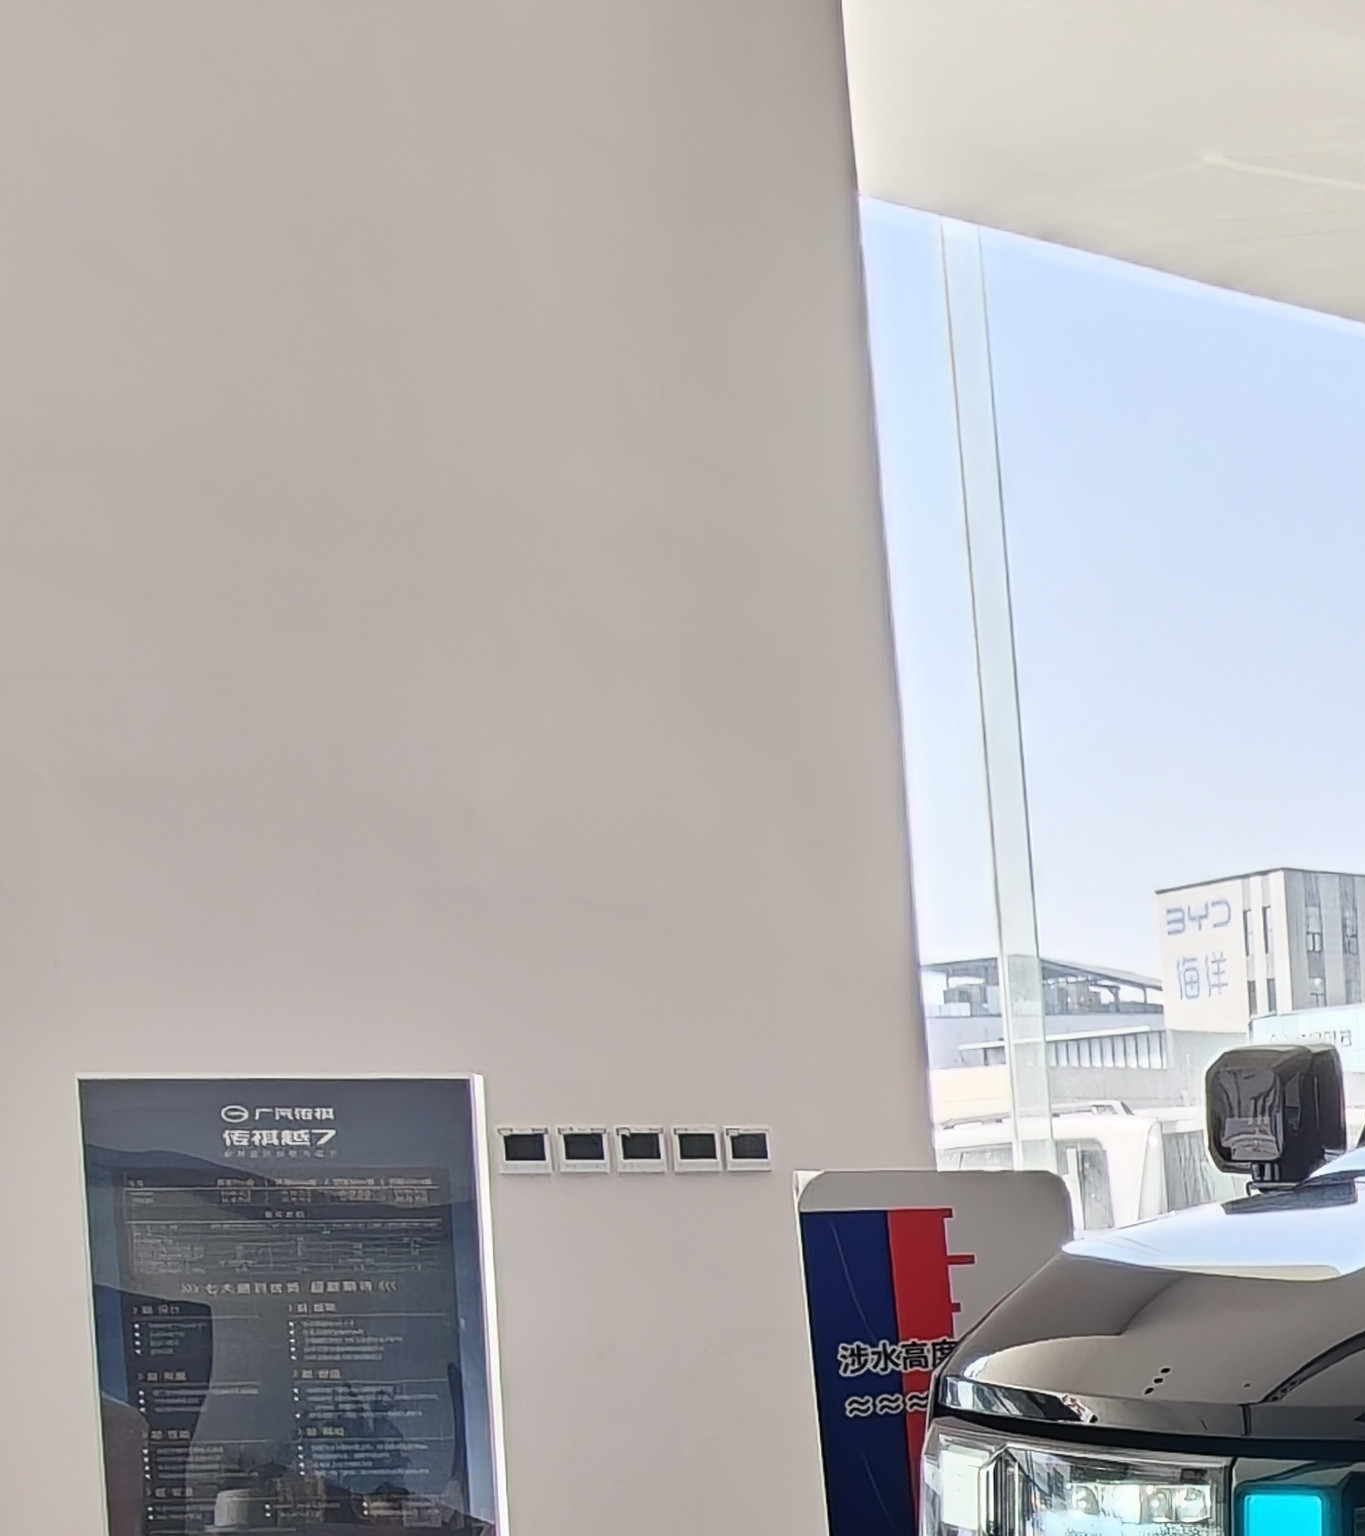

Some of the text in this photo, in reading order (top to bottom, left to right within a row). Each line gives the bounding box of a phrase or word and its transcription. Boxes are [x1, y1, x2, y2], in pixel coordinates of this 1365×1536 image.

[1166, 899, 1231, 936] BYD
[1176, 952, 1229, 1000] 海洋
[223, 1129, 337, 1146] 传祺越7
